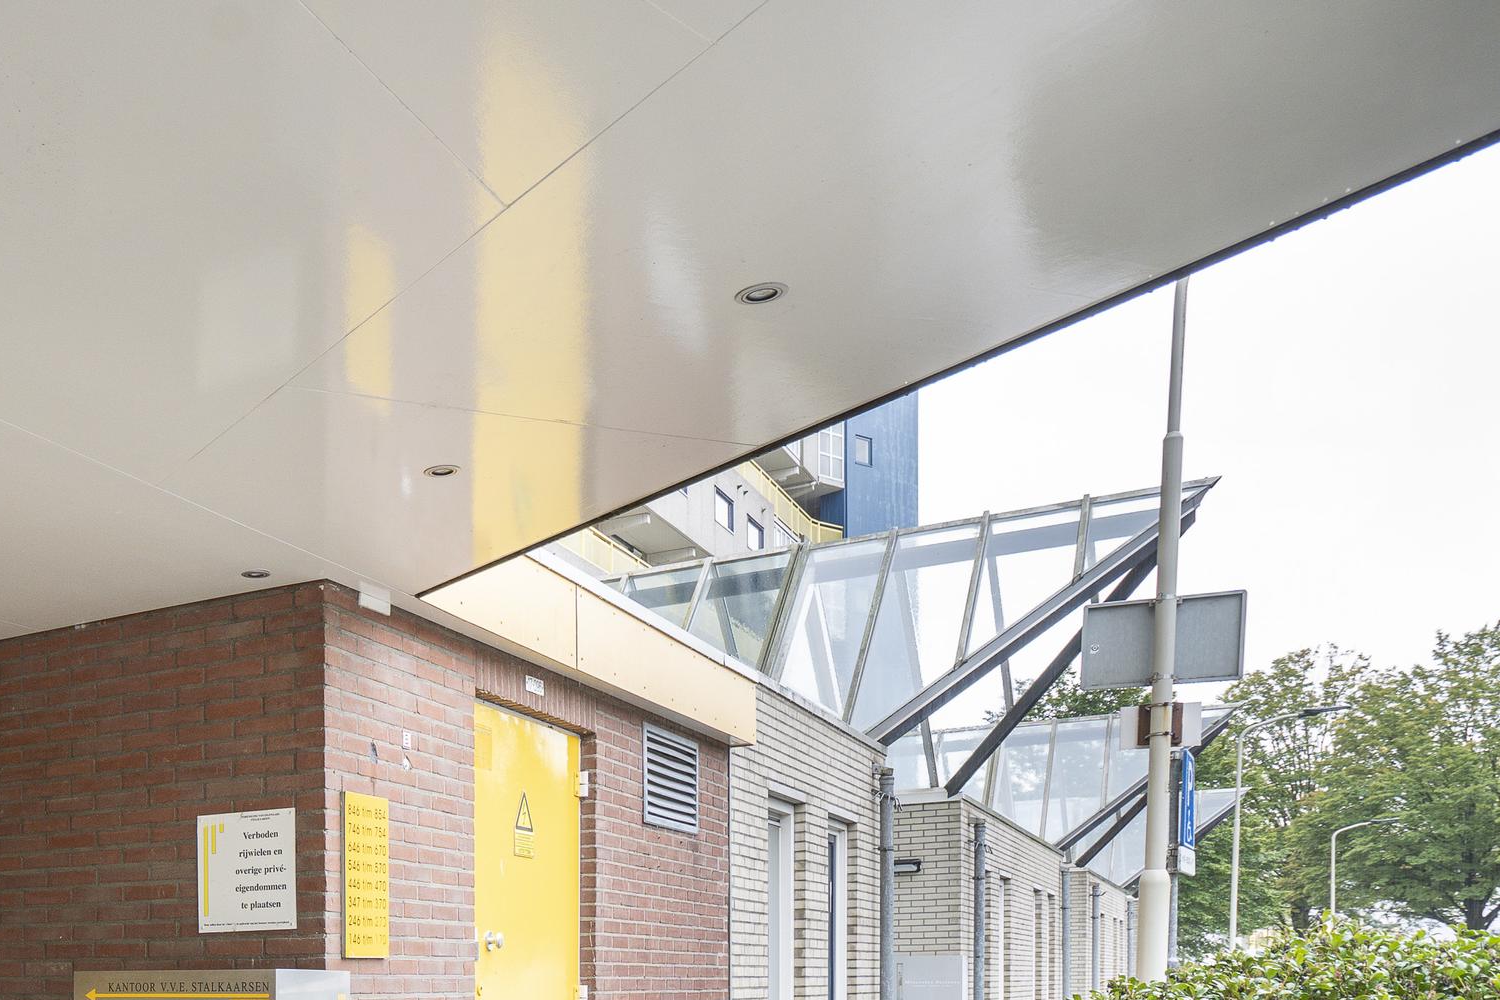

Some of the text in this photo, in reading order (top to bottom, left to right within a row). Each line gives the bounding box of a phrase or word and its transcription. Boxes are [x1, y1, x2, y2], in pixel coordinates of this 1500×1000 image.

[348, 804, 360, 816] 846
[374, 809, 386, 820] 854
[243, 830, 278, 840] Verboden
[348, 822, 360, 835] 746
[374, 826, 386, 838] 754
[239, 848, 272, 859] rijwielen
[348, 841, 360, 854] 646
[374, 844, 386, 856] 670
[235, 864, 286, 875] overige privé-
[348, 859, 360, 871] 546
[374, 862, 386, 874] 570
[235, 884, 287, 893] eigendommen
[348, 878, 360, 890] 446
[374, 880, 386, 892] 470
[250, 901, 281, 910] plaatsen
[348, 896, 360, 908] 347
[374, 898, 386, 909] 370
[348, 914, 360, 926] 246
[348, 933, 360, 944] 146
[108, 982, 269, 992] KANTOOR V.V.E. STALKAARSEN
